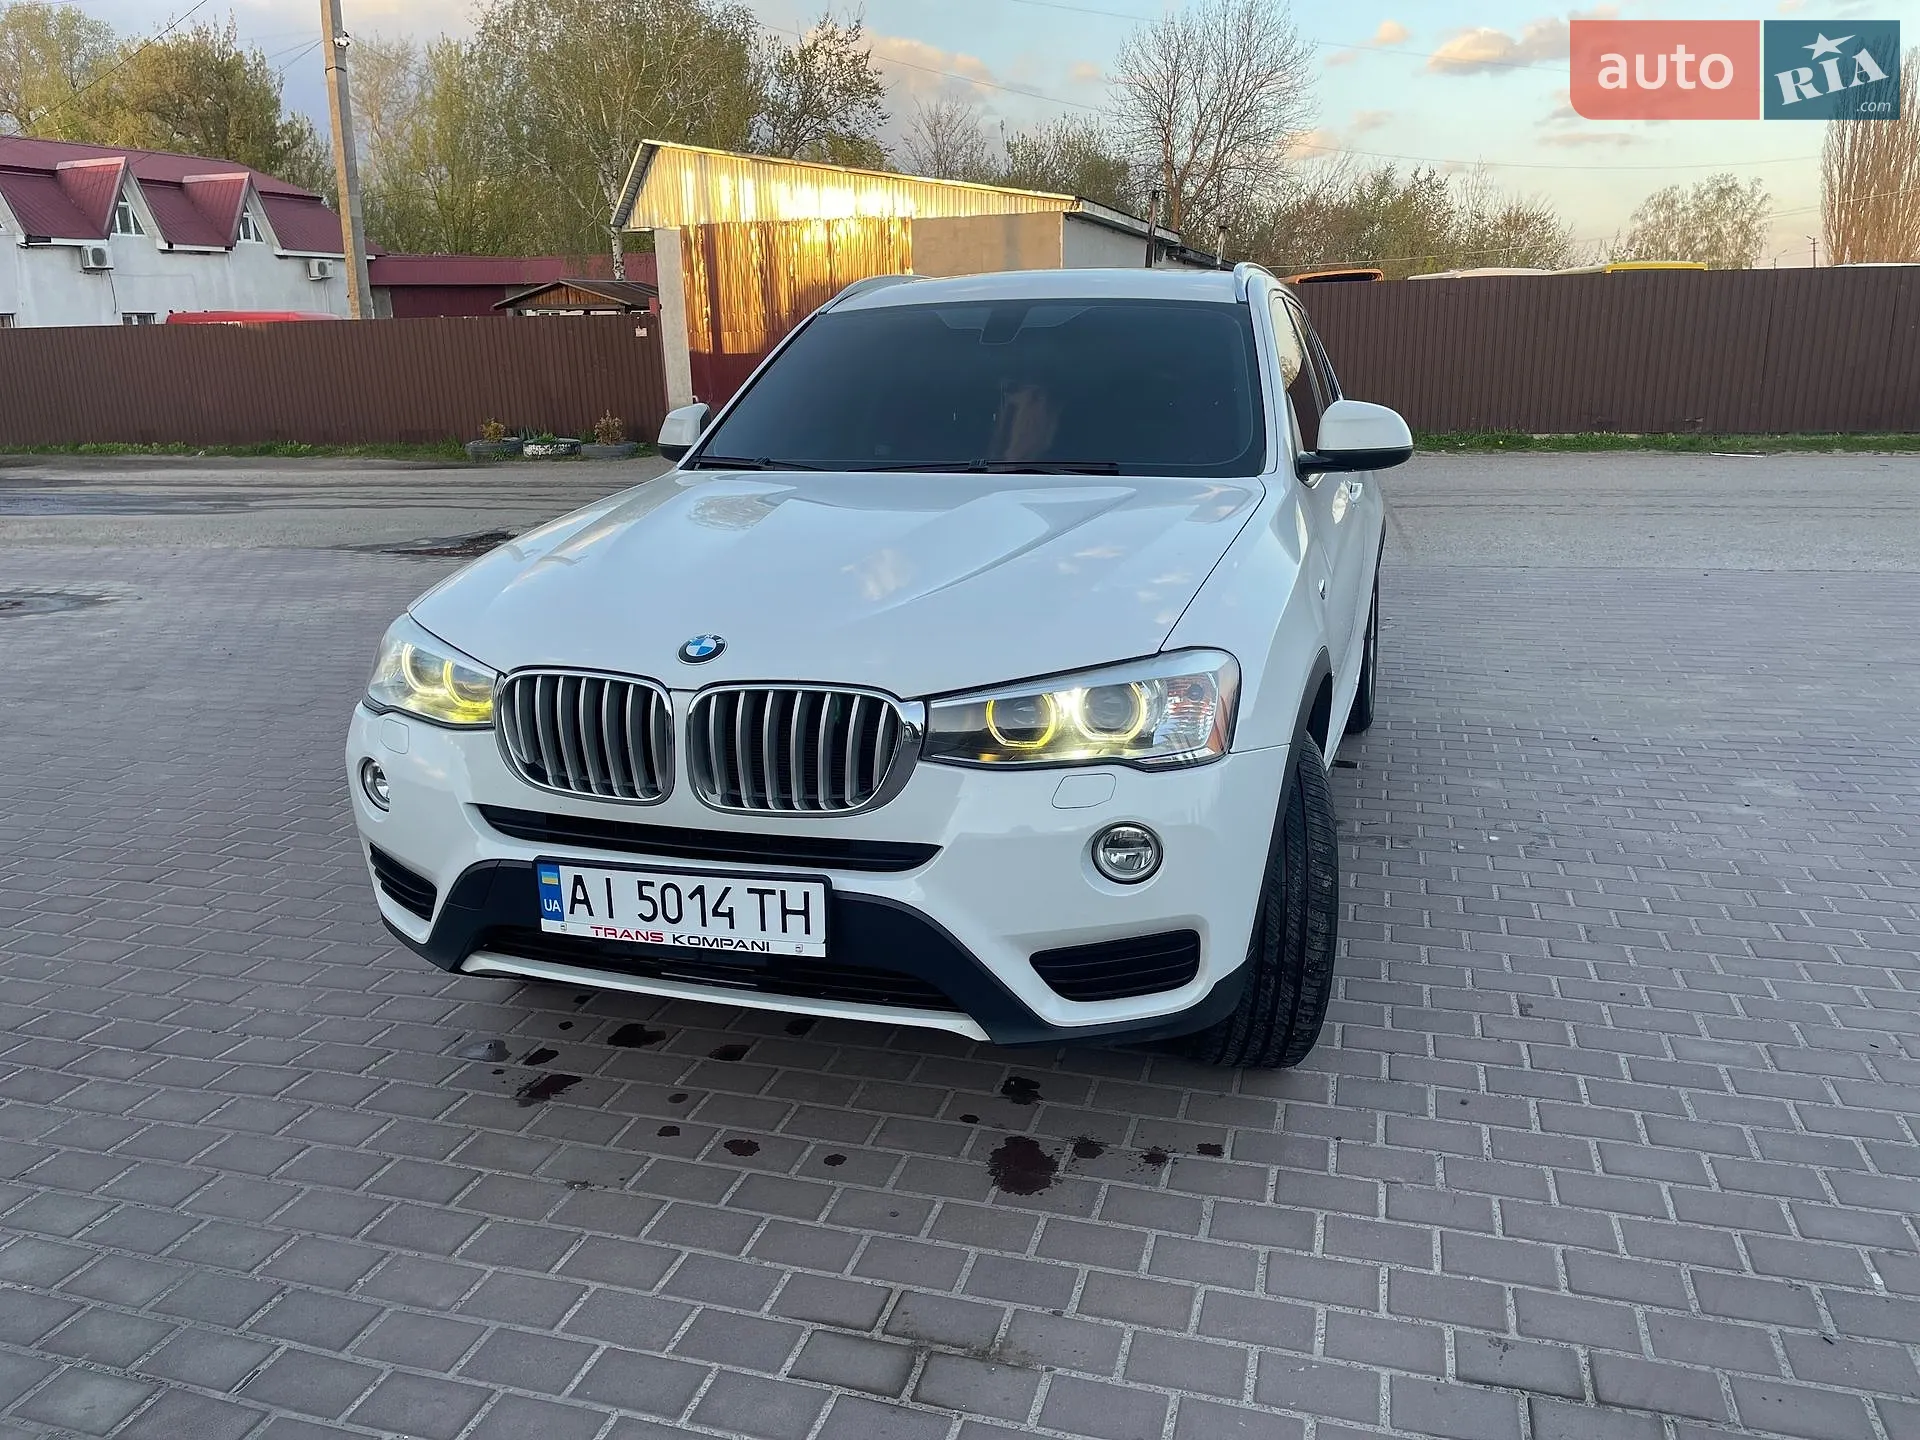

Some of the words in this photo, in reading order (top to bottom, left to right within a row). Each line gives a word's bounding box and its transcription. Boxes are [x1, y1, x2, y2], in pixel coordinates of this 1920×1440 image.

[543, 898, 562, 913] UA
[568, 874, 615, 919] AI
[636, 879, 736, 930] 5014
[746, 886, 812, 935] TH
[590, 926, 664, 943] TRANS
[672, 933, 771, 952] KOMPANI
